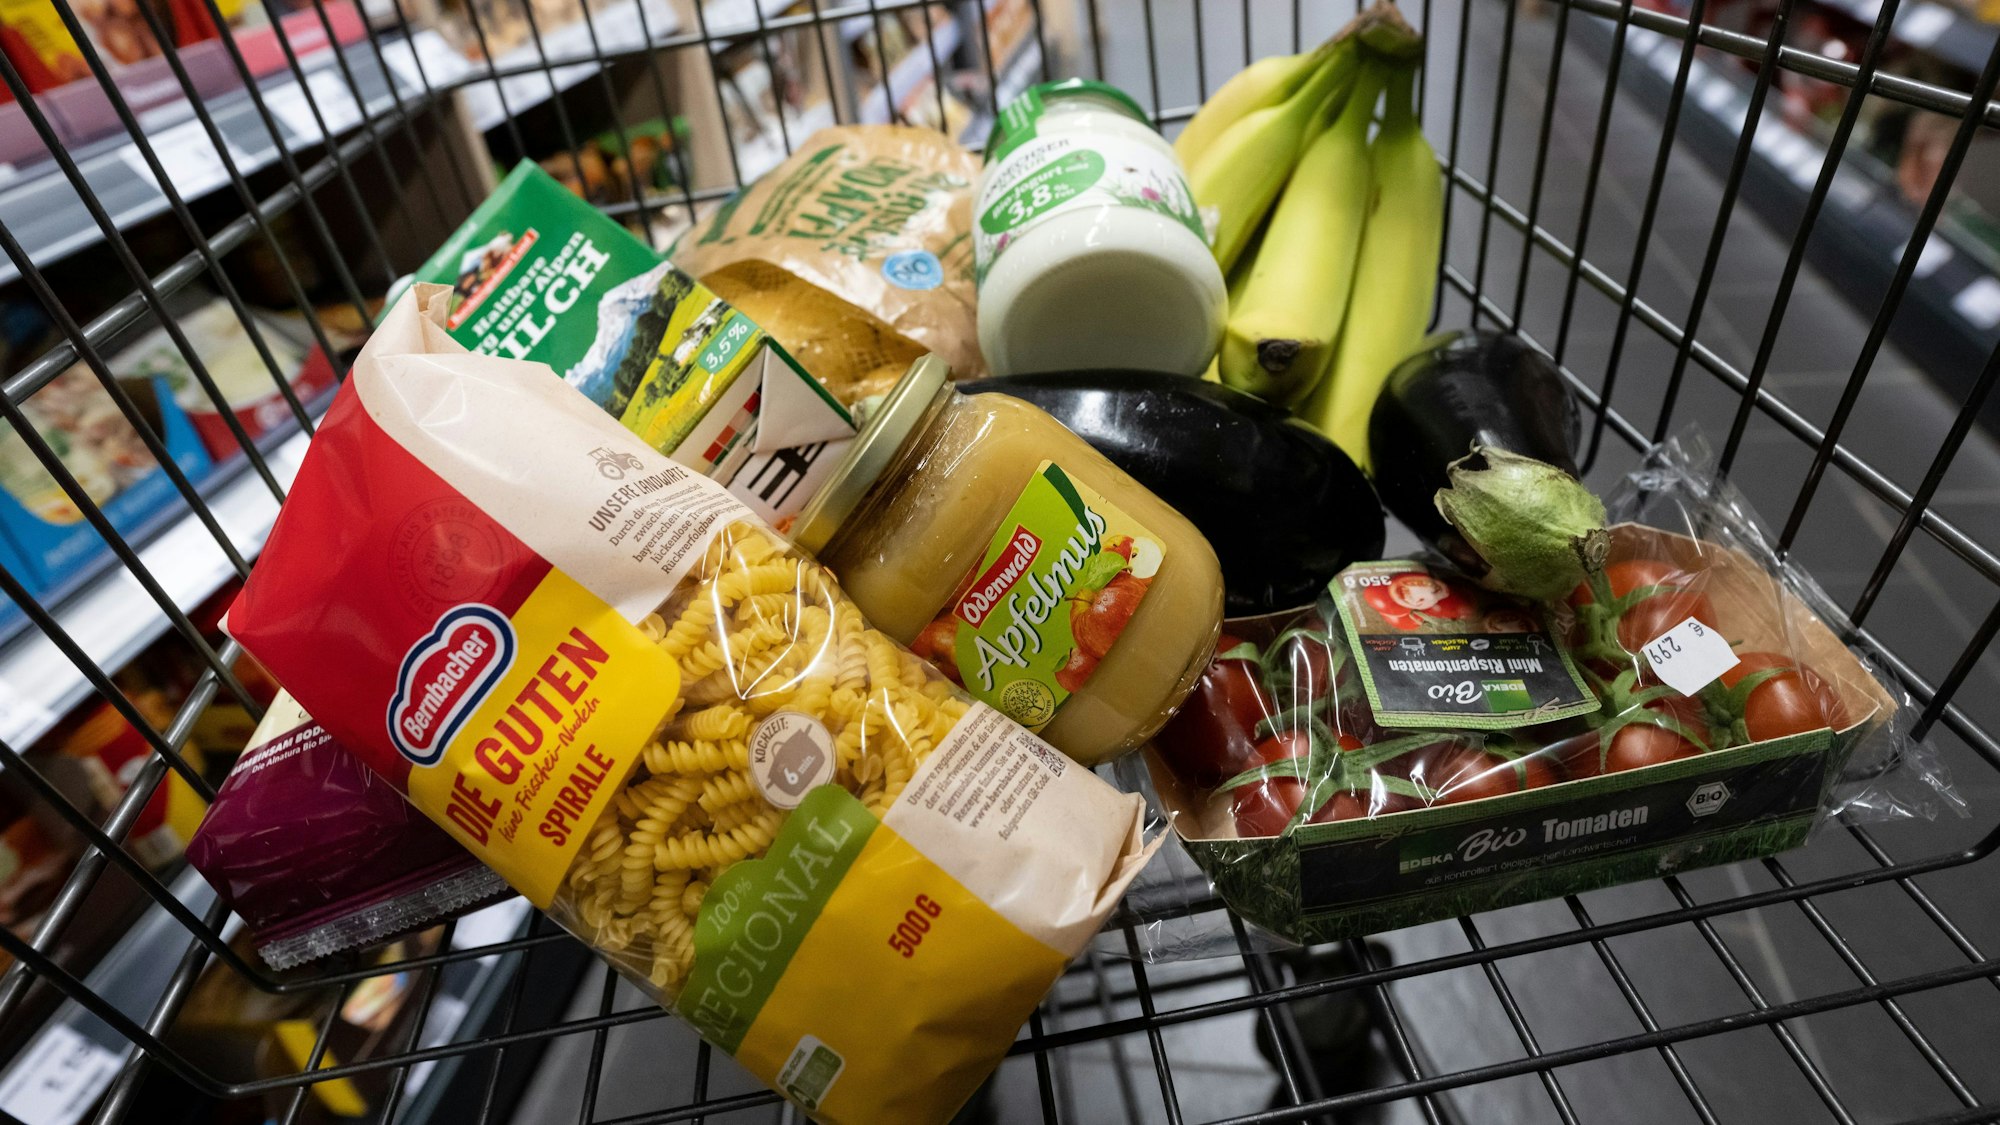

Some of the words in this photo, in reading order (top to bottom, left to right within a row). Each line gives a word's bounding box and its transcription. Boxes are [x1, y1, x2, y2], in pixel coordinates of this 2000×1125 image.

[1008, 184, 1053, 225] 3,8
[472, 257, 546, 337] Haltbare
[487, 239, 611, 361] ILCH
[496, 290, 536, 333] und
[533, 231, 585, 292] Alpen
[588, 484, 640, 533] UNSERE
[636, 466, 690, 496] LANDWIRTE
[633, 507, 666, 543] zwischen
[609, 519, 636, 547] Durch
[634, 507, 647, 520] die
[632, 512, 680, 563] bayerischen
[650, 521, 692, 564] lückenlose
[962, 533, 1037, 624] Odenwald
[974, 506, 1106, 692] Apfelmus
[1359, 575, 1392, 587] 350
[403, 629, 489, 742] Bernbacher
[1389, 657, 1506, 675] Rispentomaten
[1481, 683, 1527, 692] EDEKA
[1509, 658, 1544, 673] Mini
[1428, 680, 1483, 705] Bio
[231, 737, 293, 777] GEMEINSAM
[252, 763, 265, 774] Die
[266, 748, 301, 767] Alnatura
[303, 741, 317, 752] Bio
[445, 771, 503, 847] DIE
[474, 626, 610, 786] GUTEN
[515, 697, 600, 811] Frischei-Nudeln
[755, 717, 789, 763] KOCHZEIT:
[538, 743, 616, 847] SPIRALE
[783, 767, 799, 785] 6
[906, 772, 937, 806] Unsere
[934, 734, 968, 774] regionalen
[925, 788, 940, 810] der
[937, 753, 974, 793] Hartweizen
[972, 740, 981, 752] &
[978, 731, 989, 745] die
[938, 771, 976, 816] Eiernudeln
[953, 786, 985, 822] Rezepte
[980, 766, 1000, 789] finden
[996, 755, 1007, 767] Sie
[1005, 741, 1018, 758] auf
[969, 752, 1029, 828] www.bernbacher.de
[1000, 793, 1017, 814] oder
[1014, 773, 1032, 795] nutzen
[1029, 762, 1040, 775] Sie
[998, 797, 1032, 841] folgenden
[1399, 852, 1453, 872] EDEKA
[1457, 827, 1527, 862] Bio
[1542, 805, 1649, 843] Tomaten
[1424, 875, 1442, 885] aus
[1444, 863, 1499, 882] kontrolliert
[1562, 835, 1638, 858] Landwirtschaft
[707, 877, 753, 935] 100%
